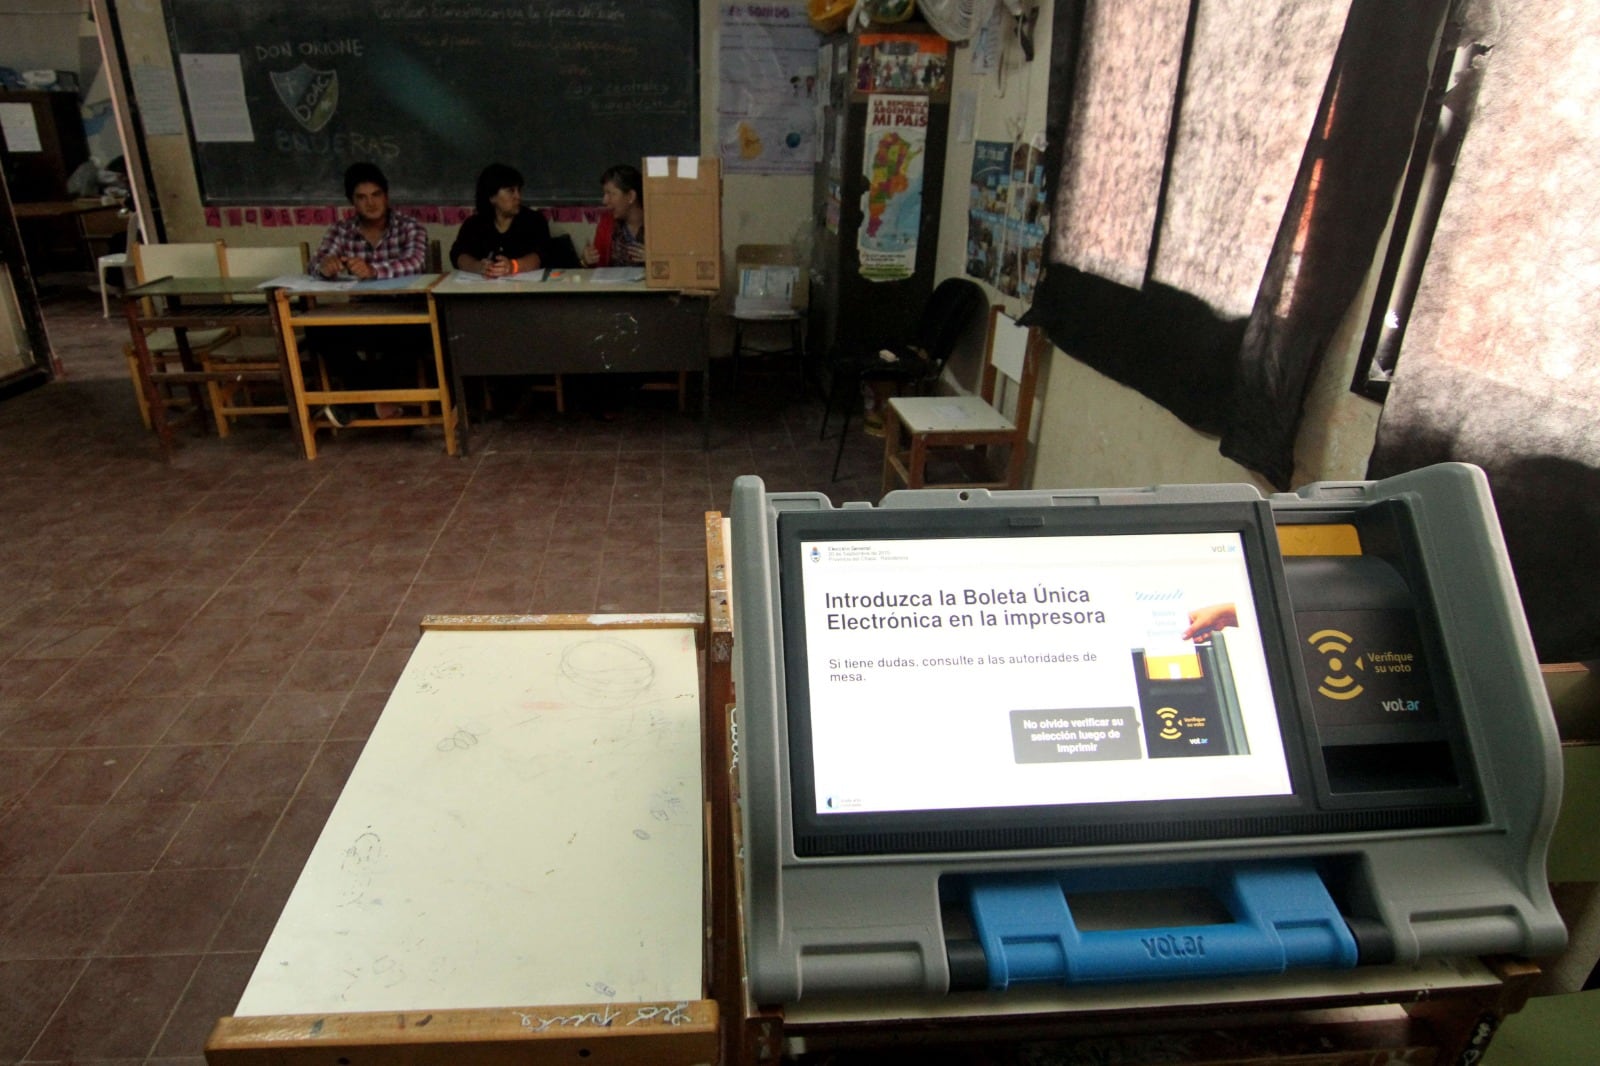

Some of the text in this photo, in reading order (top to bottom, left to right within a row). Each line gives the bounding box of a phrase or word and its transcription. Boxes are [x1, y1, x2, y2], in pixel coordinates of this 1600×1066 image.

[255, 39, 364, 61] DON ORIONE
[872, 114, 891, 126] MI
[825, 583, 1091, 609] Introduzca la Boleta Única
[827, 609, 1106, 630] Electrónica en la impresora
[829, 658, 841, 669] Si
[844, 658, 874, 669] tiene
[922, 655, 974, 667] consulte
[977, 657, 985, 666] a
[988, 654, 1005, 665] las
[1008, 652, 1079, 664] autoridades
[1082, 651, 1097, 662] de
[1367, 651, 1413, 663] Verifique
[1374, 664, 1411, 673] su voto
[830, 672, 867, 682] mesa.
[1381, 698, 1420, 712] vot.ar
[1023, 717, 1124, 729] No olvide verificar su
[1031, 729, 1120, 742] selección luego de
[1057, 742, 1098, 754] imprimir
[1140, 933, 1206, 958] vot.ar
